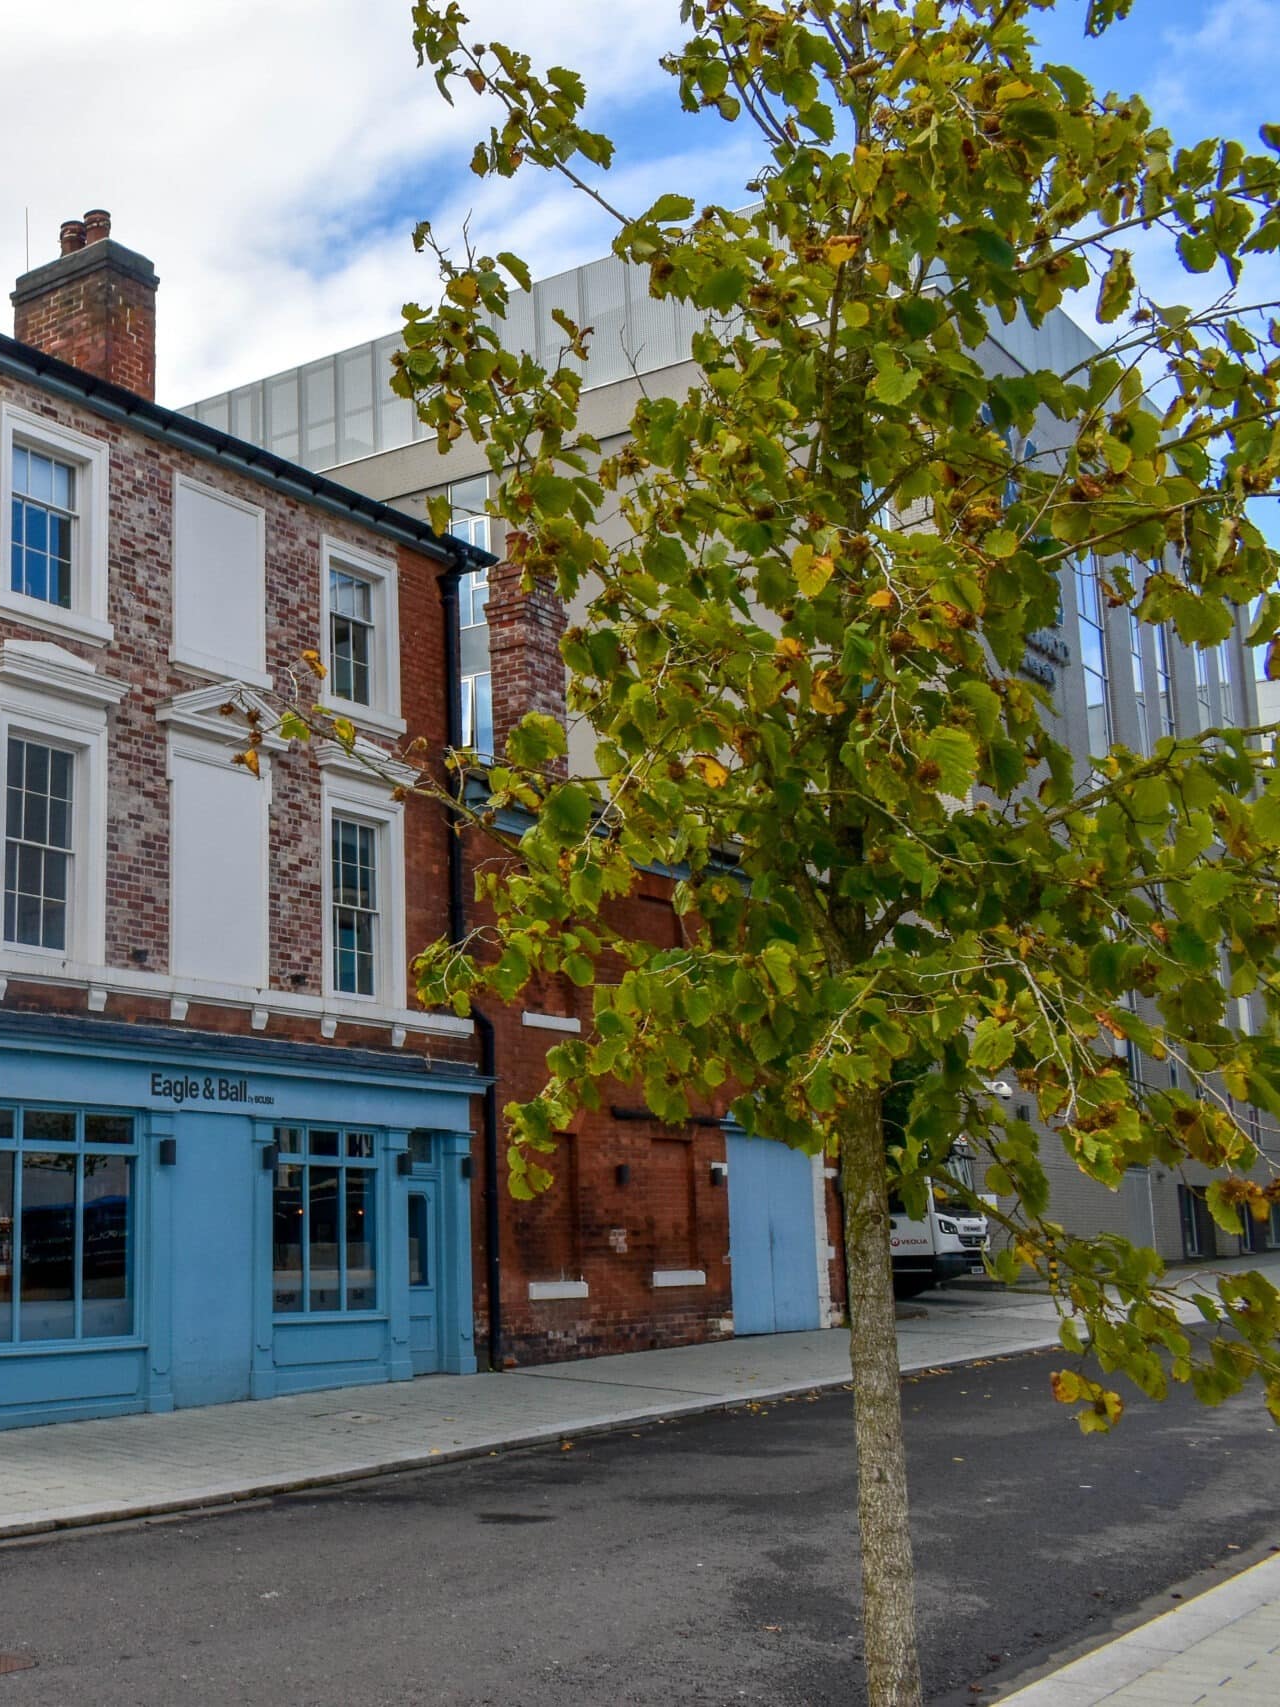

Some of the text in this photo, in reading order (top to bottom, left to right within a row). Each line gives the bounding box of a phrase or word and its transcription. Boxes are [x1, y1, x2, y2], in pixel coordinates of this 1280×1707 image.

[151, 1073, 199, 1104] Eagle
[203, 1077, 215, 1100] &
[218, 1078, 247, 1103] Ball
